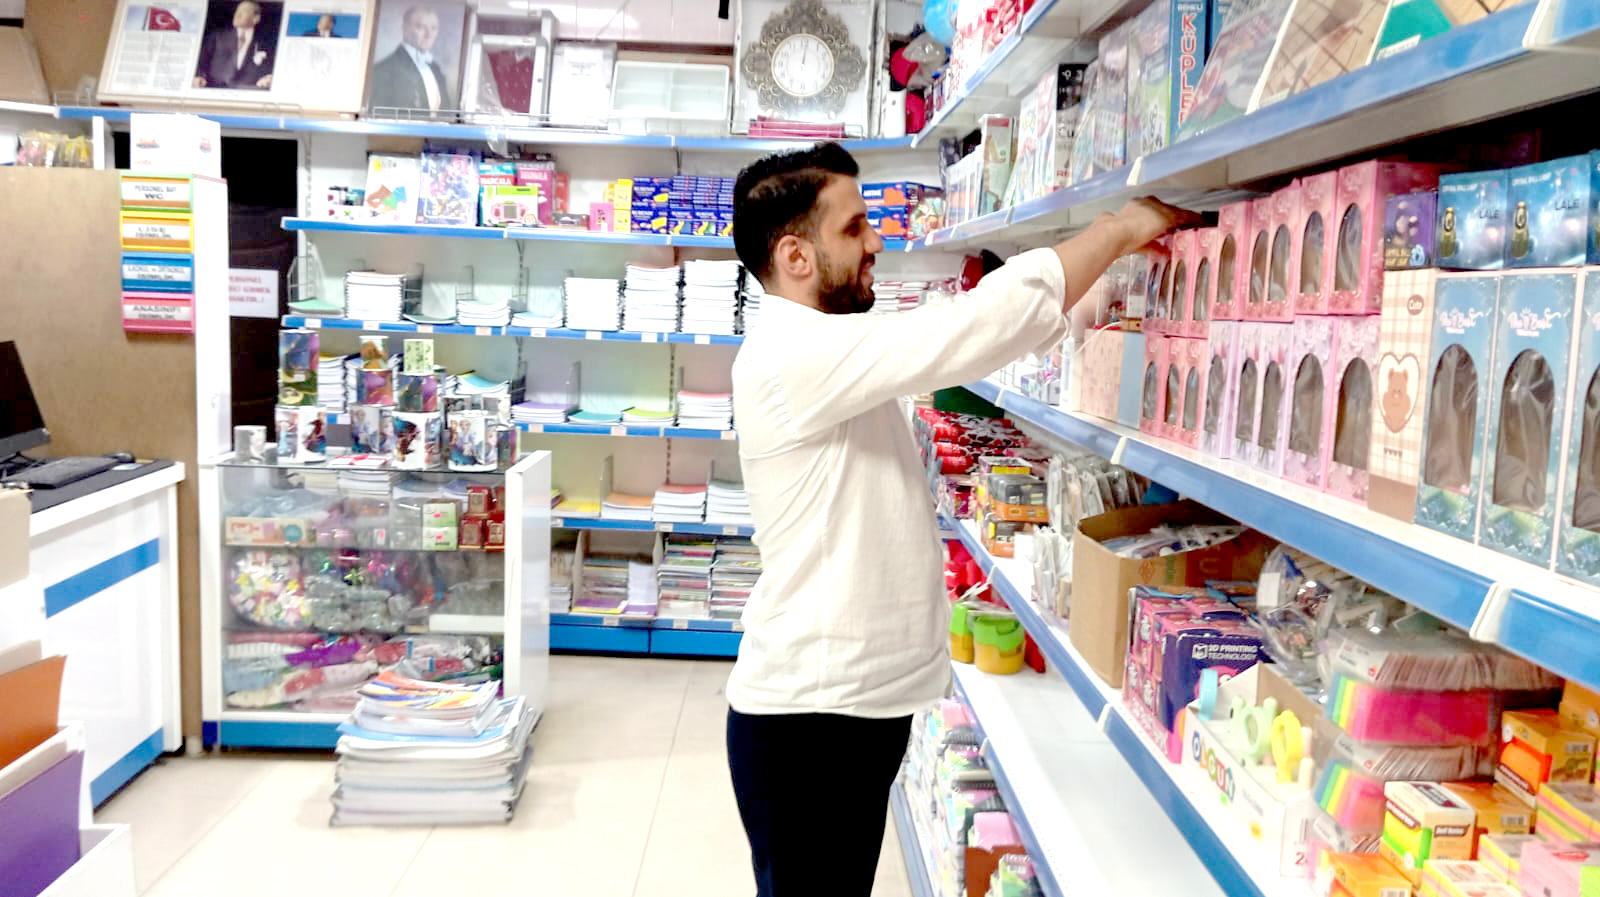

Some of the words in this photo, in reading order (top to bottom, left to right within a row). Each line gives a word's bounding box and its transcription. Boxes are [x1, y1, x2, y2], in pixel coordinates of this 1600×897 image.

[1555, 199, 1580, 211] LALE
[1479, 209, 1500, 219] LALE
[1208, 652, 1257, 660] TECHNOLOGY
